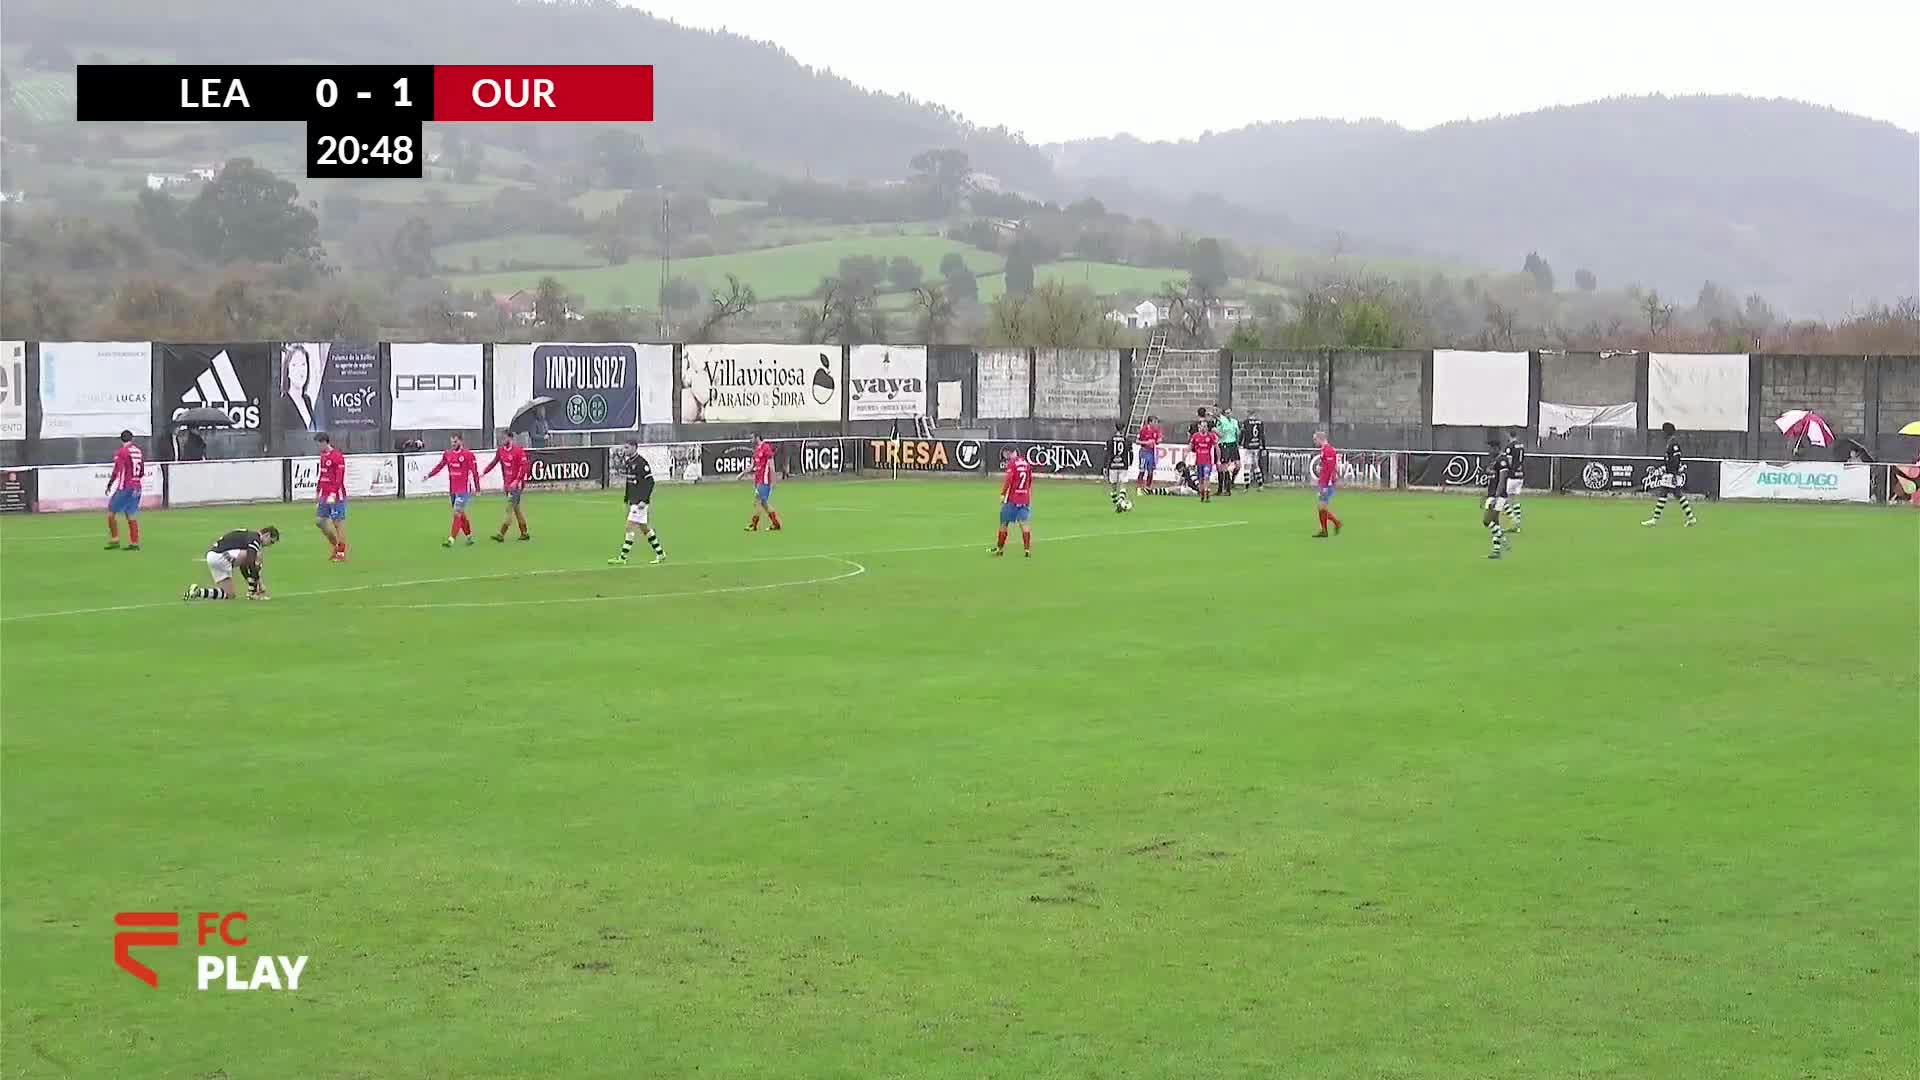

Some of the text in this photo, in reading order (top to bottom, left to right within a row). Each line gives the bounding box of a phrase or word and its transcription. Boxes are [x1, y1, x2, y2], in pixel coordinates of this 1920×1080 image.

[545, 356, 626, 389] IMPULSO27
[704, 359, 805, 386] Villaviciosa
[116, 393, 147, 402] LUCAS
[396, 374, 476, 398] peon
[851, 377, 922, 400] yaya
[332, 393, 362, 408] MGS
[871, 441, 948, 464] TRESA
[1027, 444, 1093, 472] CORTINA
[1113, 441, 1124, 455] 19
[532, 460, 590, 480] GAITERO
[1757, 472, 1838, 486] AGROLAGO
